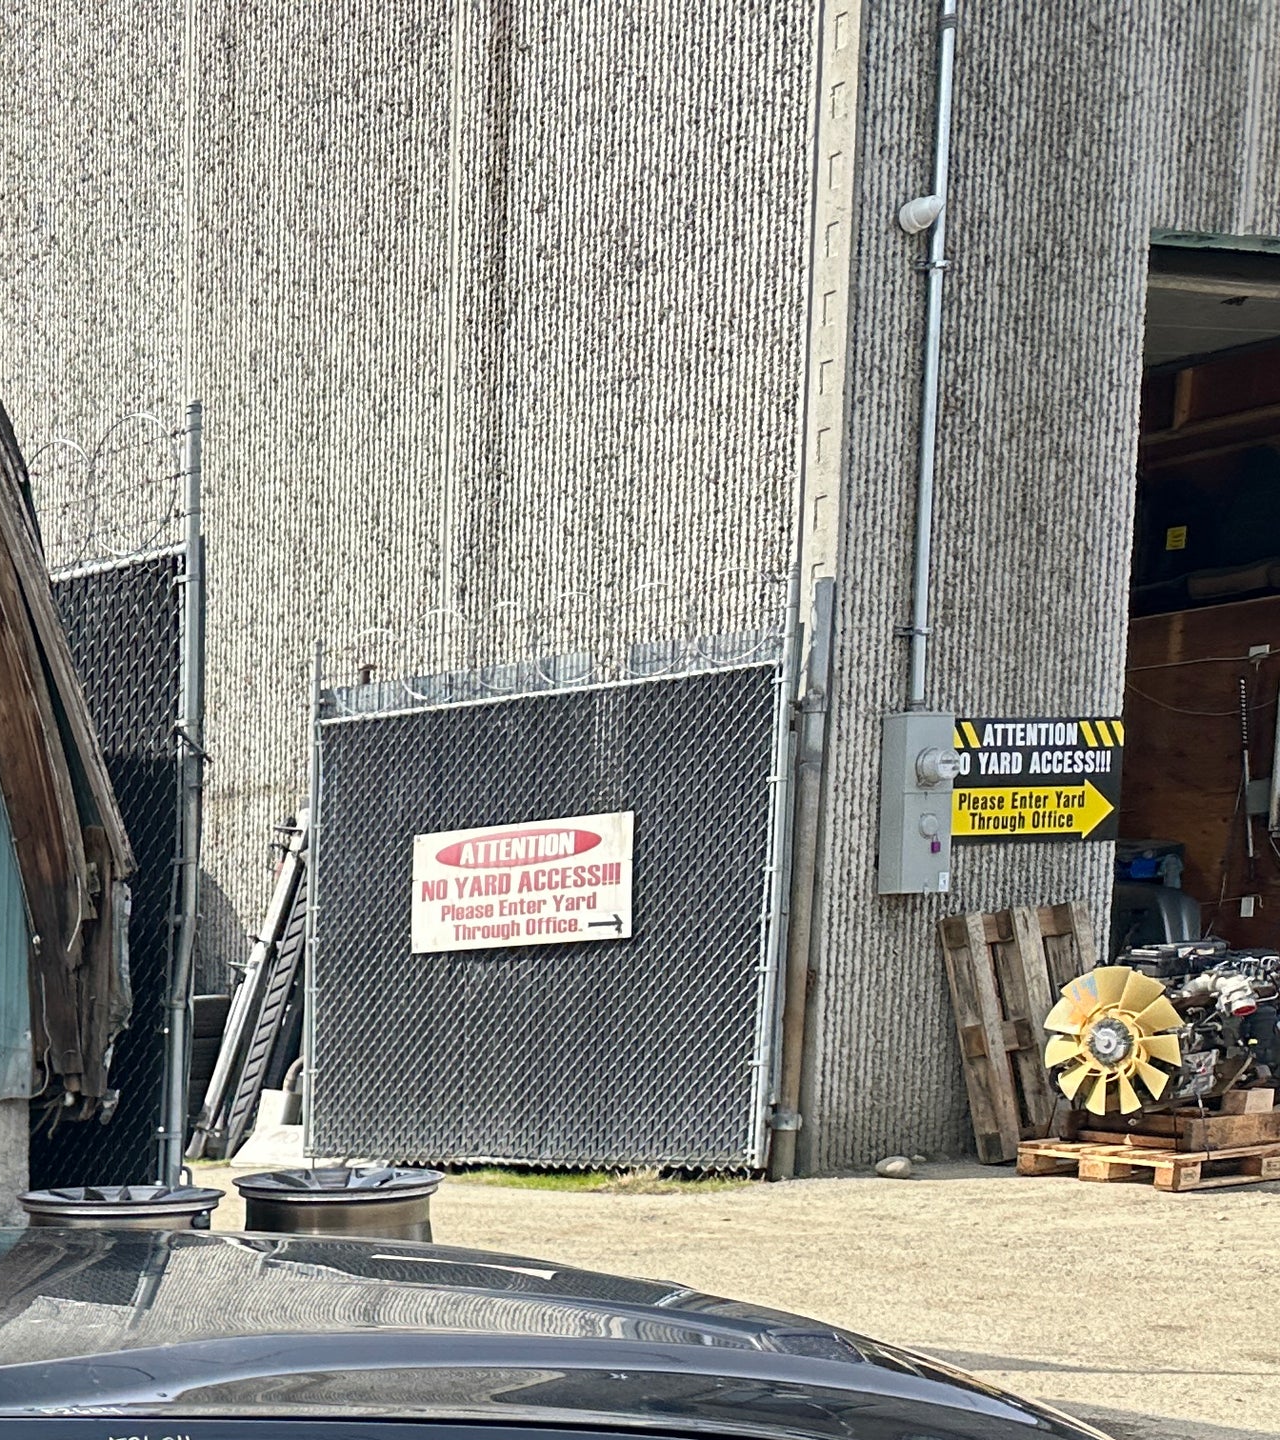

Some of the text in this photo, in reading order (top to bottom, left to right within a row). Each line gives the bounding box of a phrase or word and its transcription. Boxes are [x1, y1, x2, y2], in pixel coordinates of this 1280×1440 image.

[982, 722, 1078, 747] ATTENTION
[959, 750, 1112, 776] O YARD ACCESS!!!
[958, 790, 1086, 811] Please Enter Yard
[969, 810, 1074, 832] Through Office
[459, 831, 576, 865] ATTENTION
[421, 862, 622, 902] NO YARD ACCESS!!!
[440, 891, 597, 922] Please Enter Yard
[453, 920, 520, 942] Through
